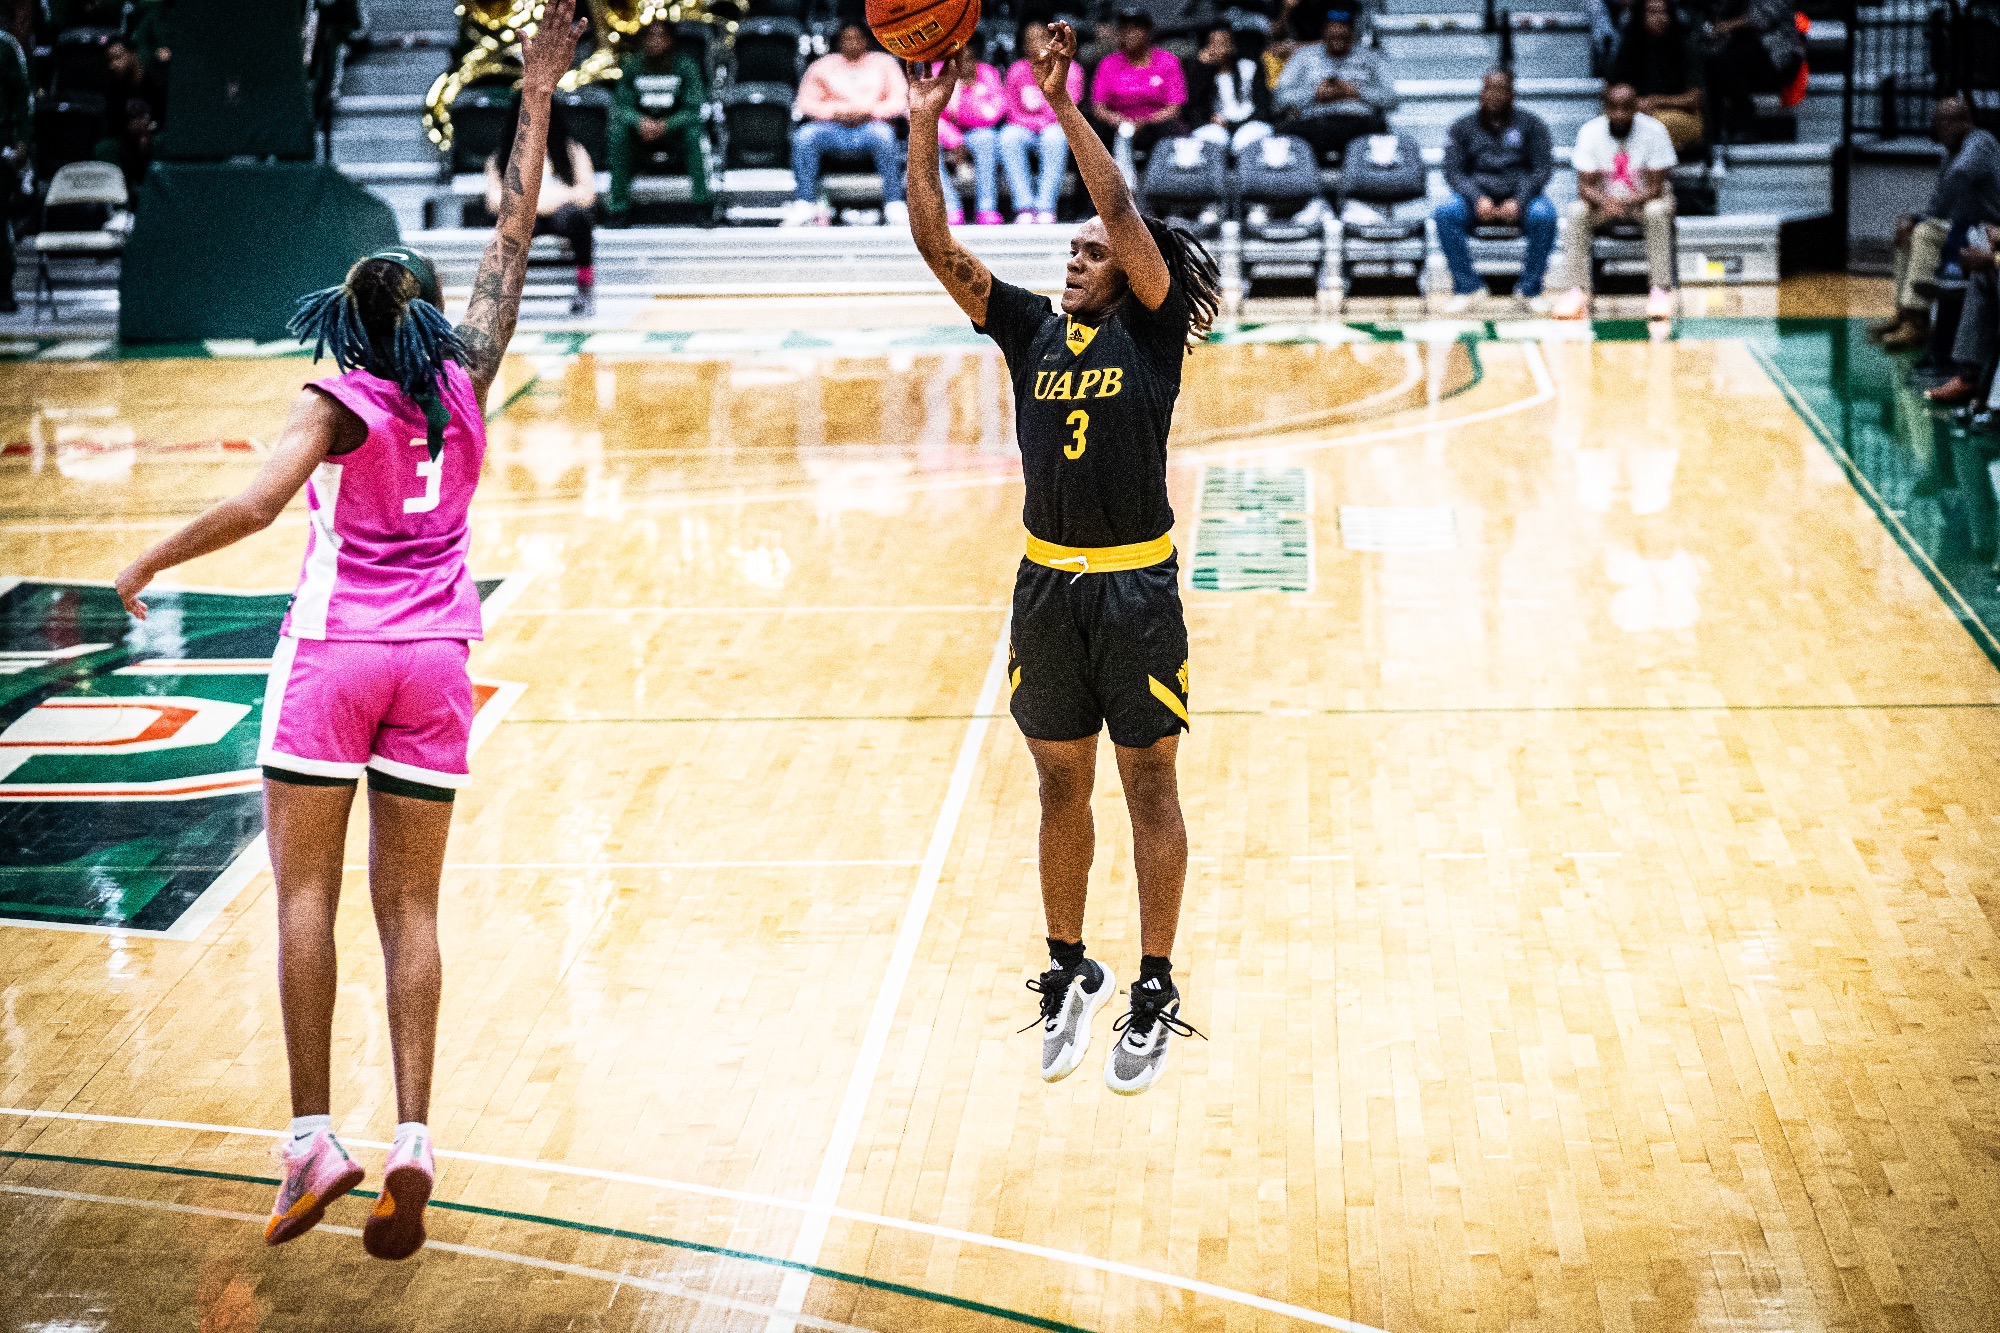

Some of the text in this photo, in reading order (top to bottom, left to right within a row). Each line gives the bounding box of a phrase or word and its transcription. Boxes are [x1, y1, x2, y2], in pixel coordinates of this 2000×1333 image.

[1034, 367, 1124, 400] UAPB
[1063, 409, 1090, 460] 3
[403, 437, 445, 514] 3
